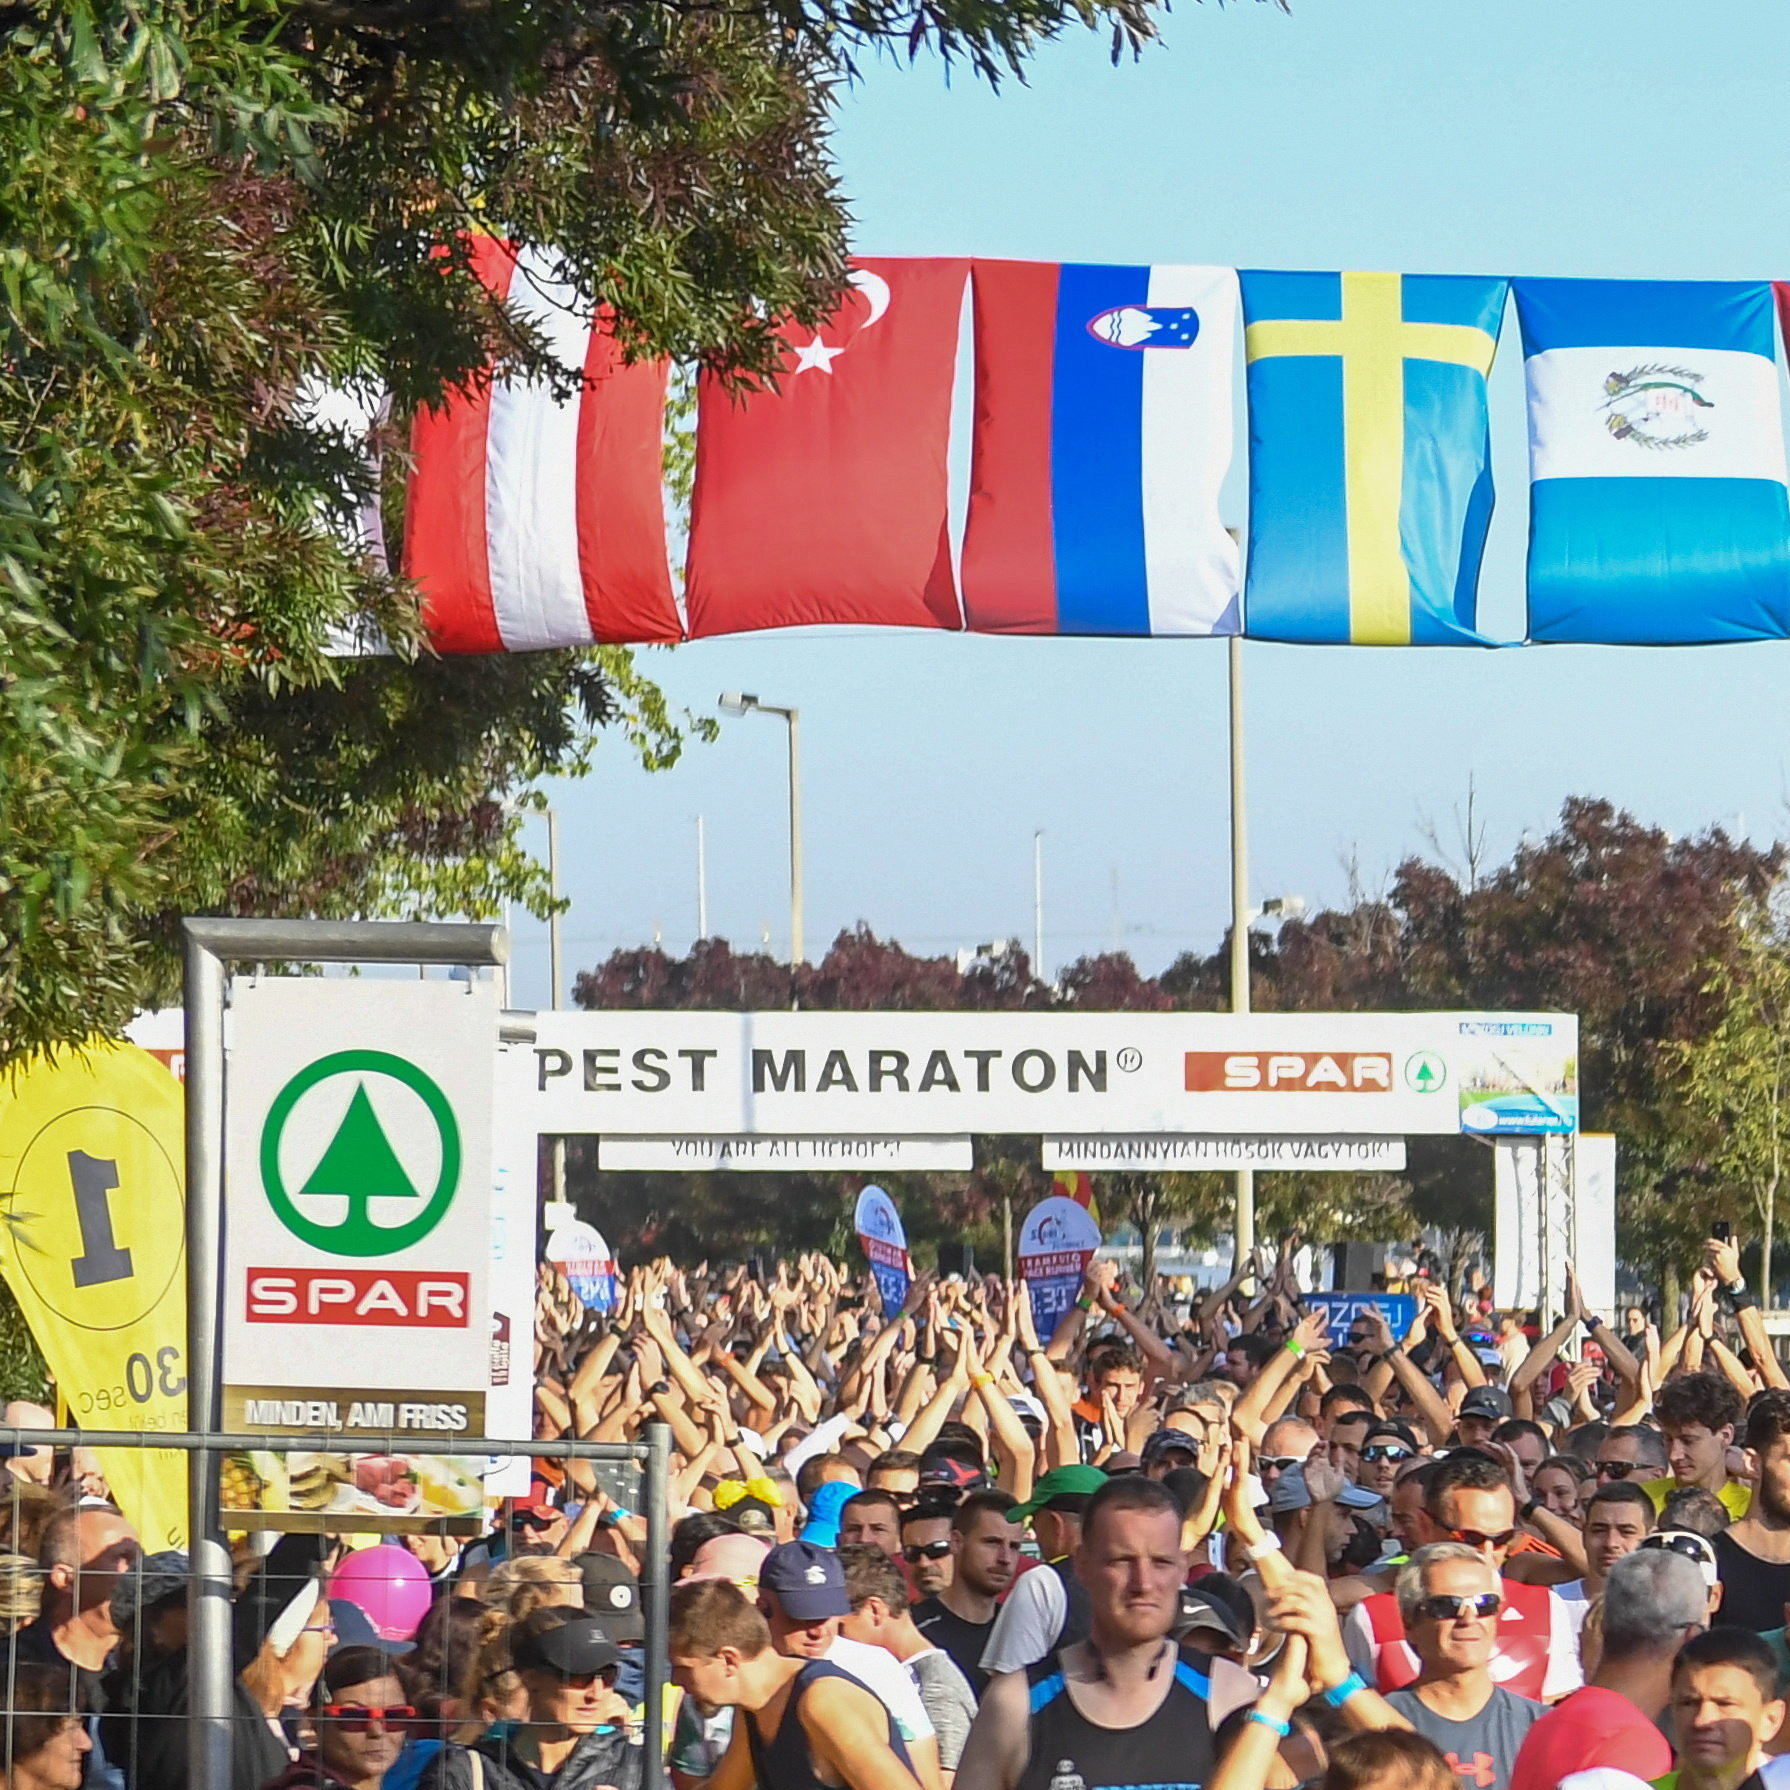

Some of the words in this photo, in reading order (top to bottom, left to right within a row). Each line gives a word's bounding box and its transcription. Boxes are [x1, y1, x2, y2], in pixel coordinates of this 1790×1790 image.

[1224, 1056, 1390, 1087] SPAR
[250, 1277, 464, 1319] SPAR
[244, 1399, 343, 1432] MINDEN,
[346, 1402, 395, 1428] AMI
[399, 1403, 468, 1431] FRISS
